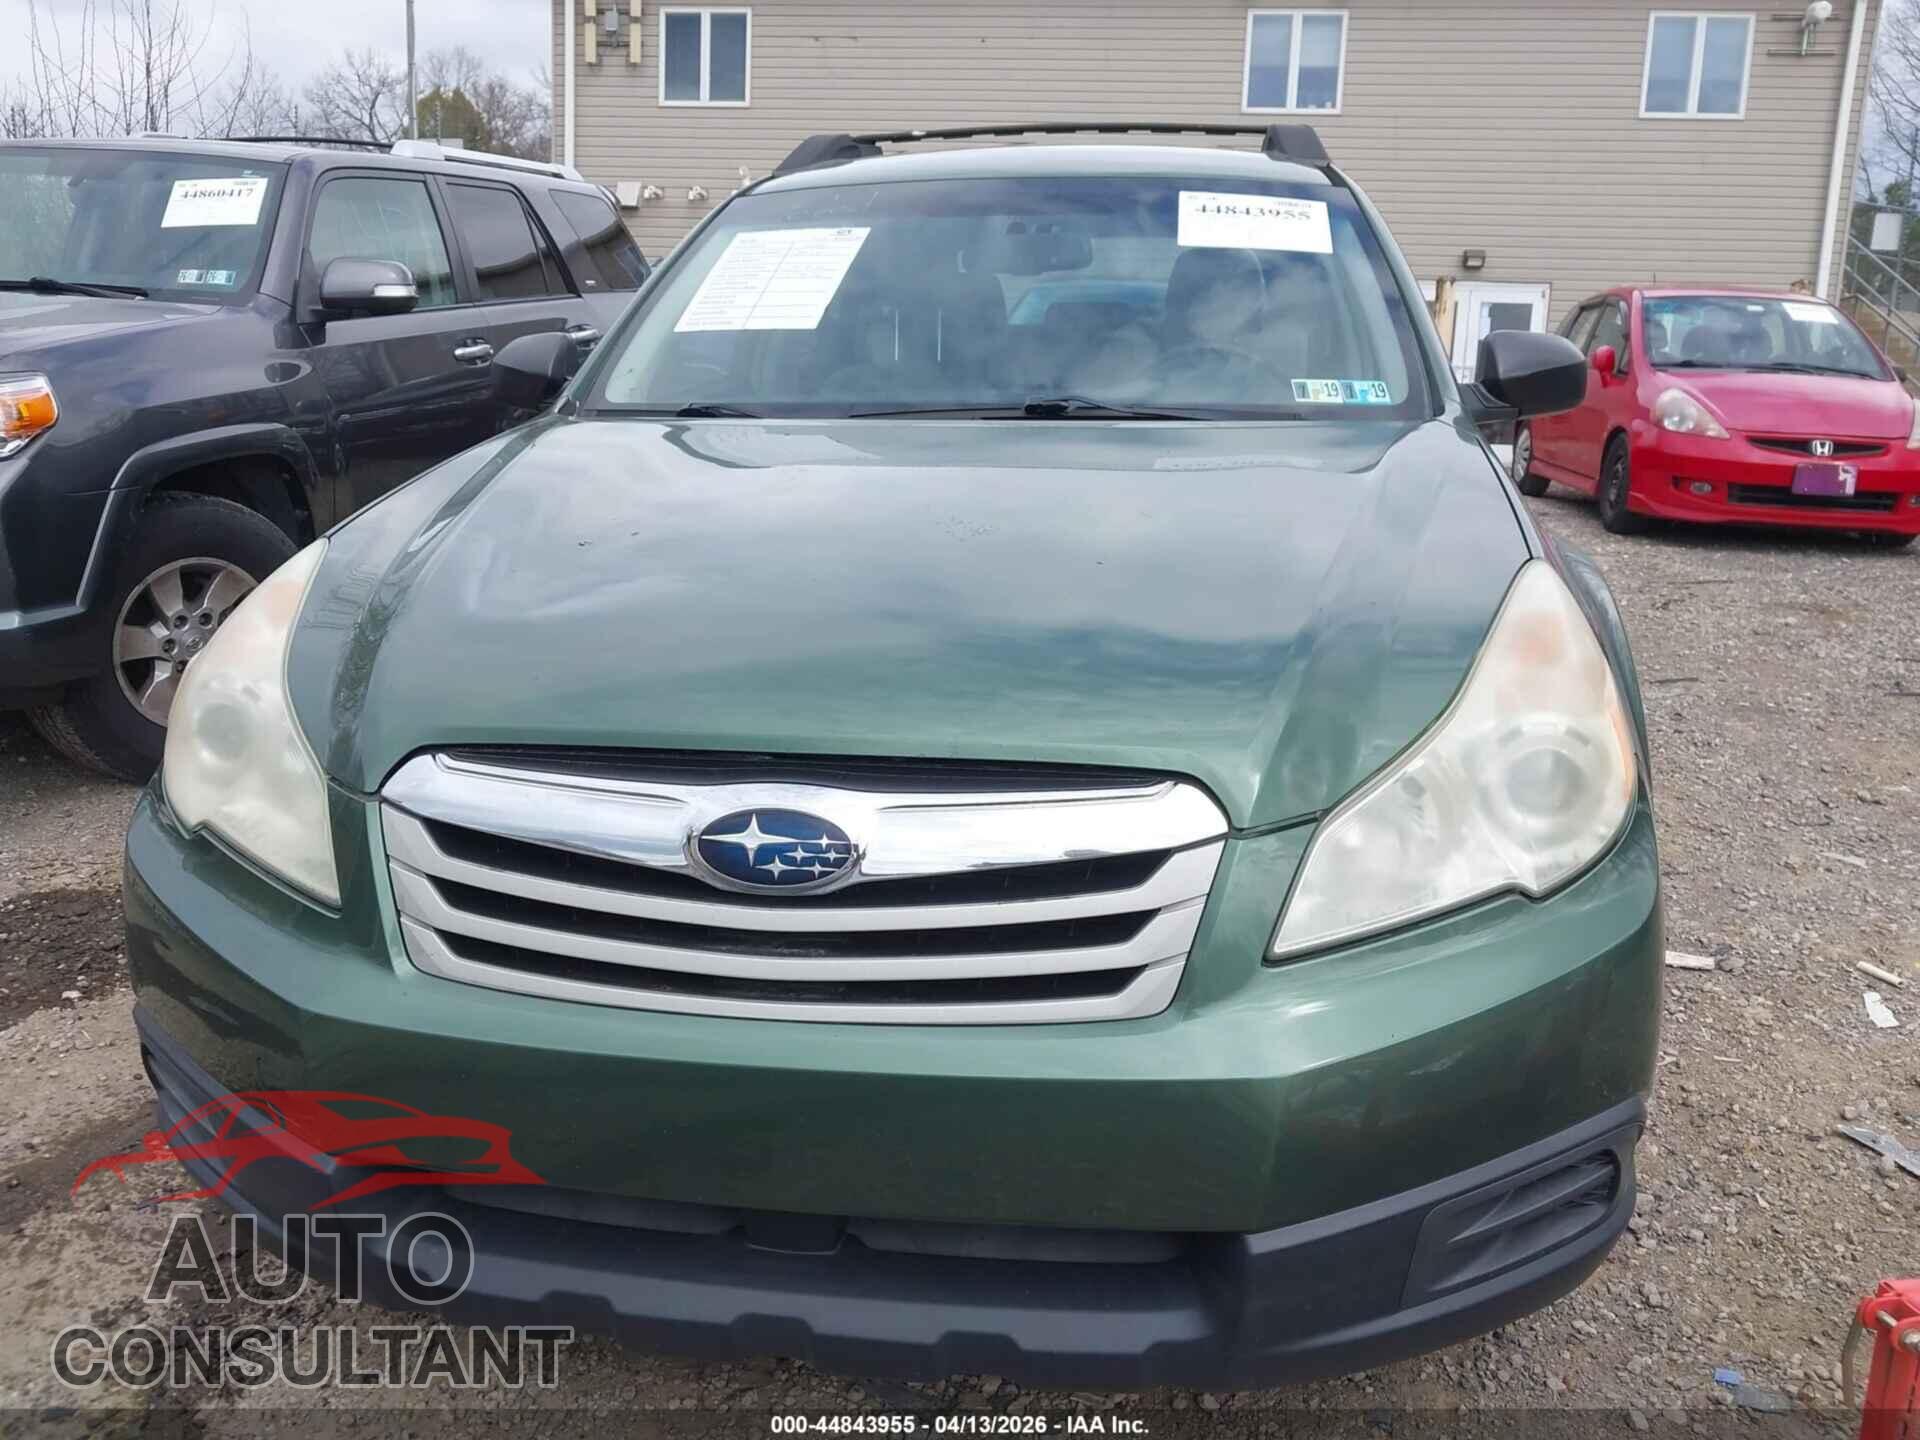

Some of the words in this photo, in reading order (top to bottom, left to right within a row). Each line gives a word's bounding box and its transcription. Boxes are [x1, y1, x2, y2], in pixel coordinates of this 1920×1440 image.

[180, 187, 255, 200] 44860417
[1195, 203, 1312, 221] 44843955
[1325, 382, 1339, 397] 19
[1372, 383, 1387, 398] 19
